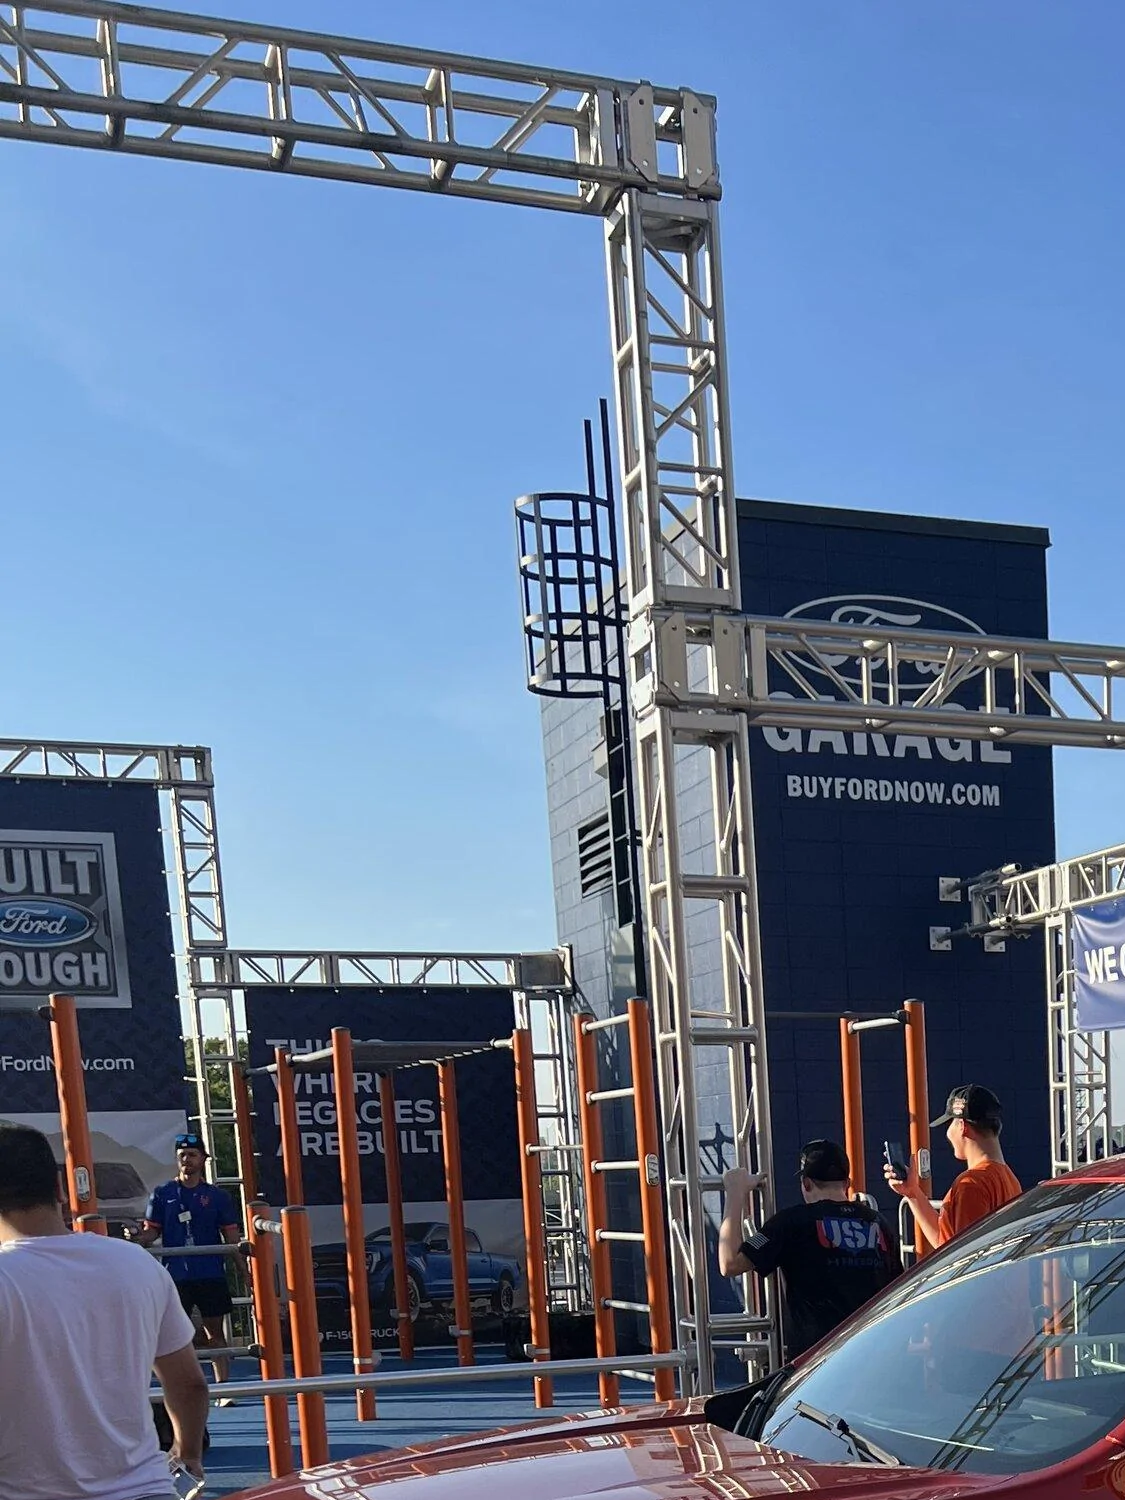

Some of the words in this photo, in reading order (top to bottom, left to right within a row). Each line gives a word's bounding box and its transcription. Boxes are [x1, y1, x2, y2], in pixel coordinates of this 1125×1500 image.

[786, 774, 1001, 807] BUYFORDNOW.COM
[0, 848, 98, 895] UILT
[0, 907, 68, 935] Ford
[0, 951, 111, 987] OUGH
[1084, 946, 1119, 985] WE
[816, 1219, 888, 1251] USA
[326, 1331, 353, 1340] F-15
[370, 1328, 400, 1338] RUCK
